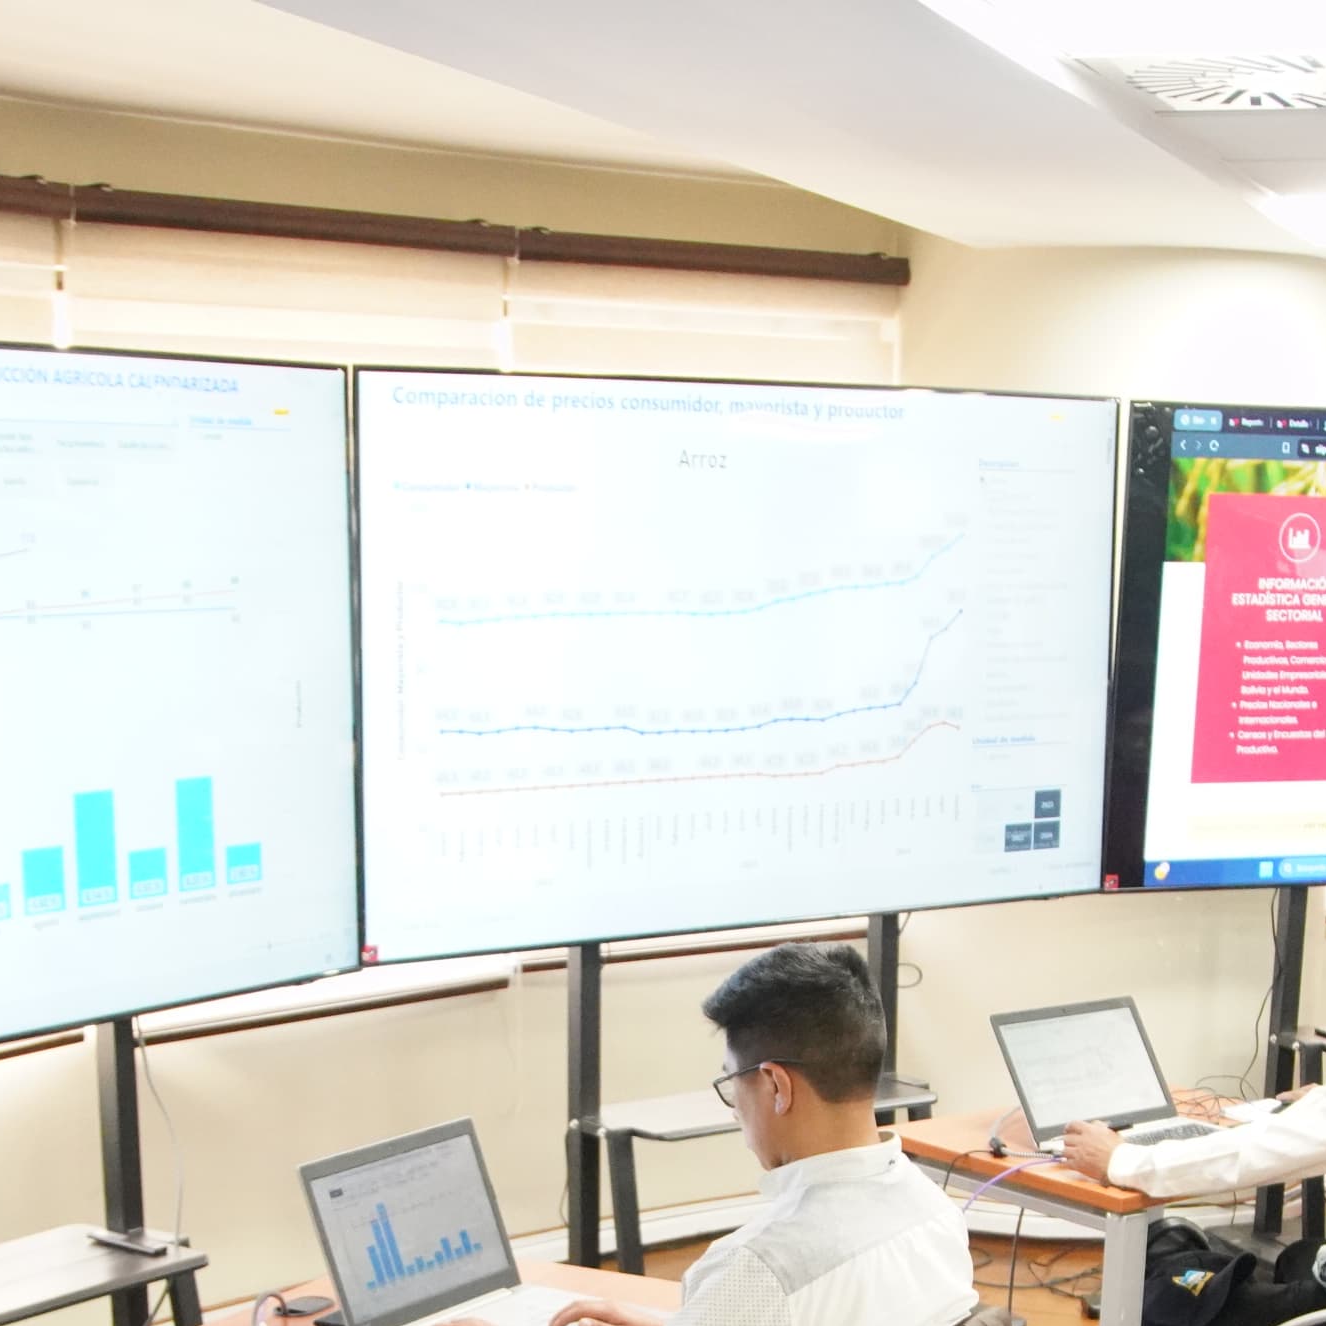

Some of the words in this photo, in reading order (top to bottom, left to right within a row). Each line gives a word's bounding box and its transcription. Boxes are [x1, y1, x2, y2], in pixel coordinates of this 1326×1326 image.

[53, 367, 124, 387] AGRÍCOLA
[524, 388, 545, 408] de
[552, 391, 614, 412] precios
[620, 391, 722, 415] consumidor,
[814, 402, 823, 421] y
[677, 449, 727, 469] Arroz
[1231, 591, 1301, 606] ESTADÍSTICA
[1265, 609, 1324, 622] SECTORIAL
